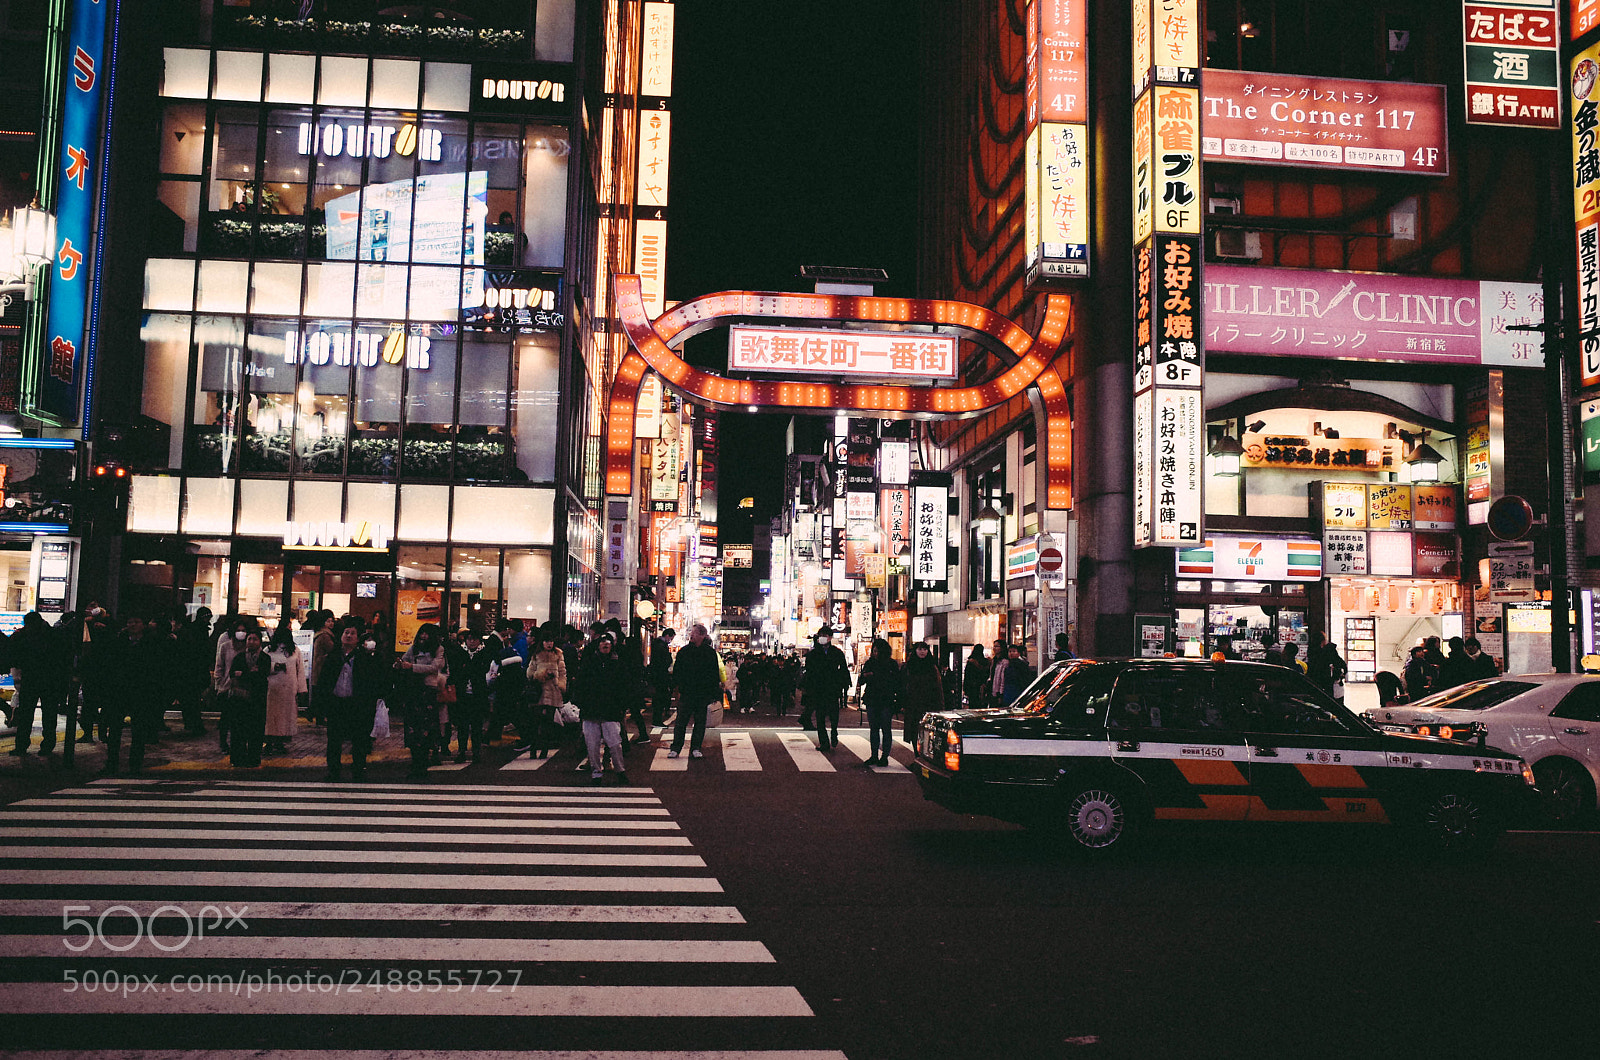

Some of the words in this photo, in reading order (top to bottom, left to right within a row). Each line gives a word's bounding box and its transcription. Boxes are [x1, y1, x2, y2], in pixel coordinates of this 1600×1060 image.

[1470, 11, 1552, 42] たばこ
[1579, 8, 1598, 32] 3F
[1044, 37, 1080, 48] Corner
[1162, 14, 1189, 61] 焼き
[1050, 50, 1074, 62] 117
[1493, 51, 1530, 80] 酒
[1179, 68, 1195, 82] 7F
[482, 79, 565, 102] DOUTOR
[1243, 84, 1378, 104] ダイニングレストラン
[1050, 93, 1076, 112] 4F
[1472, 92, 1555, 118] 銀行ATM
[1203, 96, 1258, 120] The
[1270, 101, 1365, 127] Corner
[1376, 108, 1416, 131] 117
[298, 122, 443, 162] DOUTOR
[1158, 90, 1196, 207] 麻雀ブル
[1229, 143, 1280, 155] 宴会ホール
[1289, 147, 1338, 160] 最大100名
[1412, 147, 1439, 166] 4F
[51, 0, 102, 385] ラオケ館
[1051, 193, 1078, 239] 焼き
[1166, 210, 1190, 228] 6F
[1068, 244, 1082, 258] 7F
[1048, 264, 1080, 274] 小松ビル
[1163, 240, 1194, 340] お好み焼
[1352, 290, 1477, 327] CLINIC
[1270, 326, 1368, 349] クリニック
[1406, 337, 1446, 352] 新宿院
[284, 330, 431, 369] DOUTOR
[740, 335, 948, 371] 歌舞伎町一番街
[1160, 340, 1197, 360] 本陣
[1511, 342, 1535, 361] 3F
[1166, 363, 1192, 381] 8F
[1160, 406, 1176, 524] お好み焼き本陣
[1181, 525, 1197, 538] 2F
[1341, 564, 1351, 572] 2F
[1492, 562, 1505, 572] 22
[1201, 748, 1225, 757] 1450
